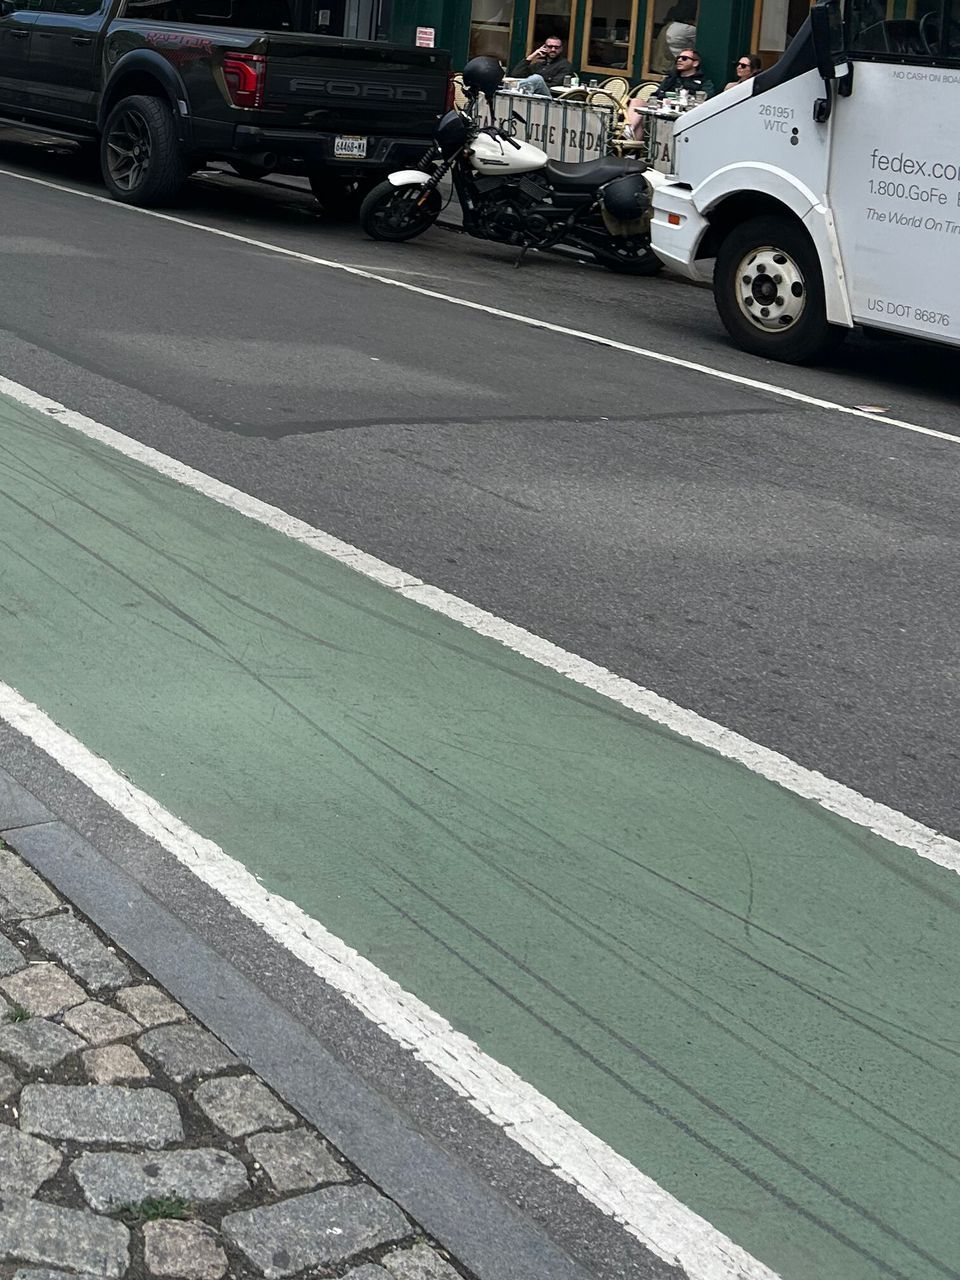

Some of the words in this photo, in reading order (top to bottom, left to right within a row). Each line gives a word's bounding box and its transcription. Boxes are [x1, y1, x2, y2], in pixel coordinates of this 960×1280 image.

[145, 32, 213, 54] RAPTOR
[892, 70, 905, 79] NO
[906, 71, 927, 81] CASH
[929, 73, 941, 82] ON
[290, 77, 427, 101] FORD
[758, 104, 795, 119] 261951
[763, 119, 788, 134] WTC
[866, 207, 887, 223] The
[888, 211, 922, 229] World
[924, 217, 942, 232] On
[867, 298, 884, 312] US
[886, 302, 912, 318] DOT
[914, 308, 950, 327] 86876
